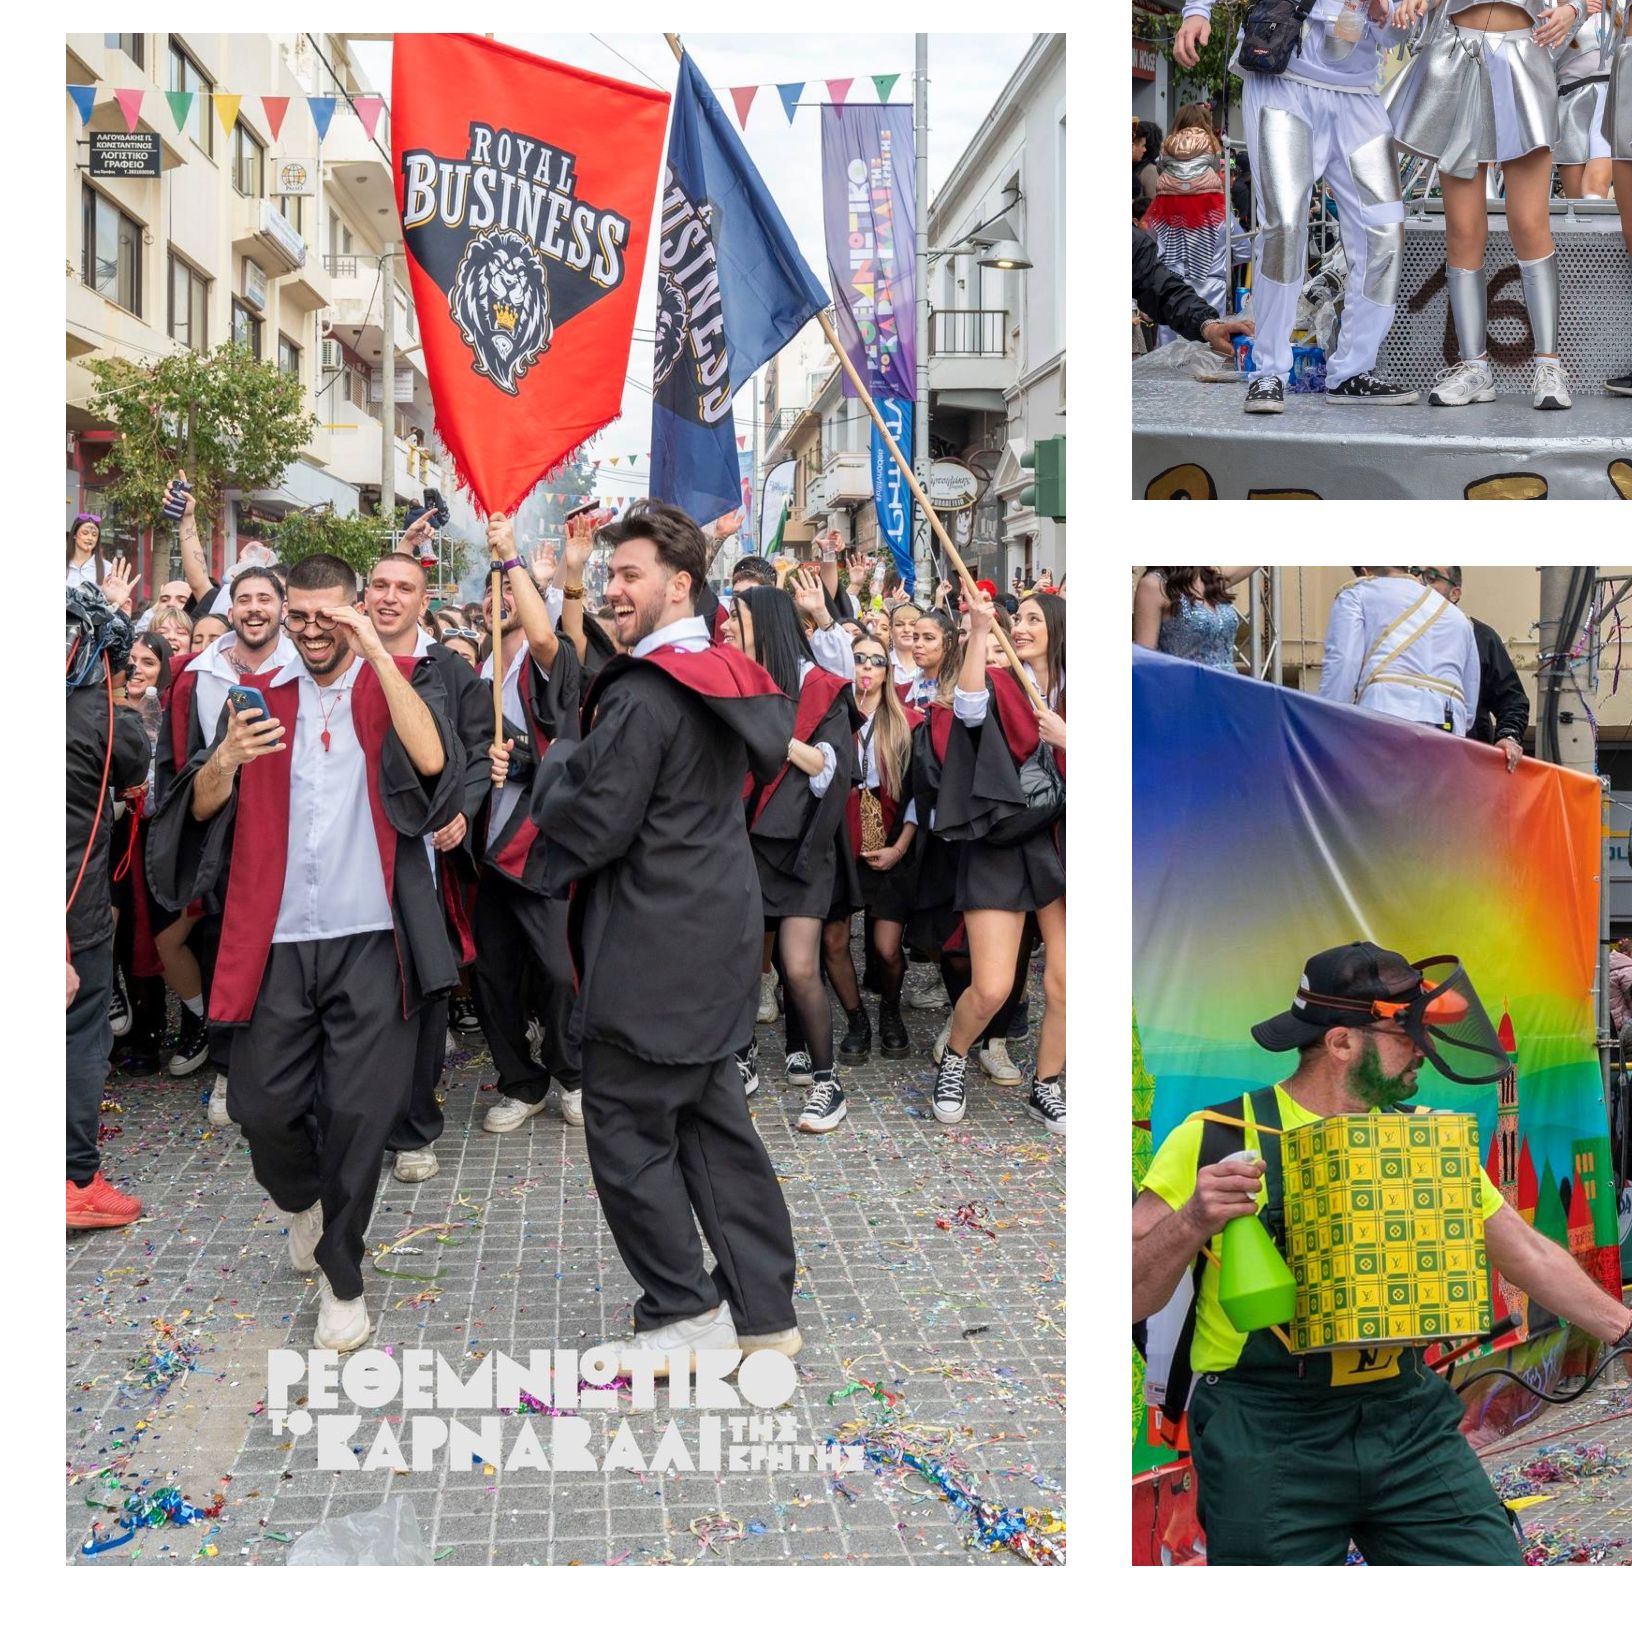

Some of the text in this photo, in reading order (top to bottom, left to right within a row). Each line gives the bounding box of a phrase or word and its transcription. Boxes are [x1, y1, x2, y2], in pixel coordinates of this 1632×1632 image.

[101, 151, 149, 160] ΛΟΓΙΣΤΙΚΟ
[104, 160, 145, 168] ΓΡΑΦΕΙΟ
[471, 127, 573, 196] ROYAL
[404, 154, 626, 288] BUSINESS
